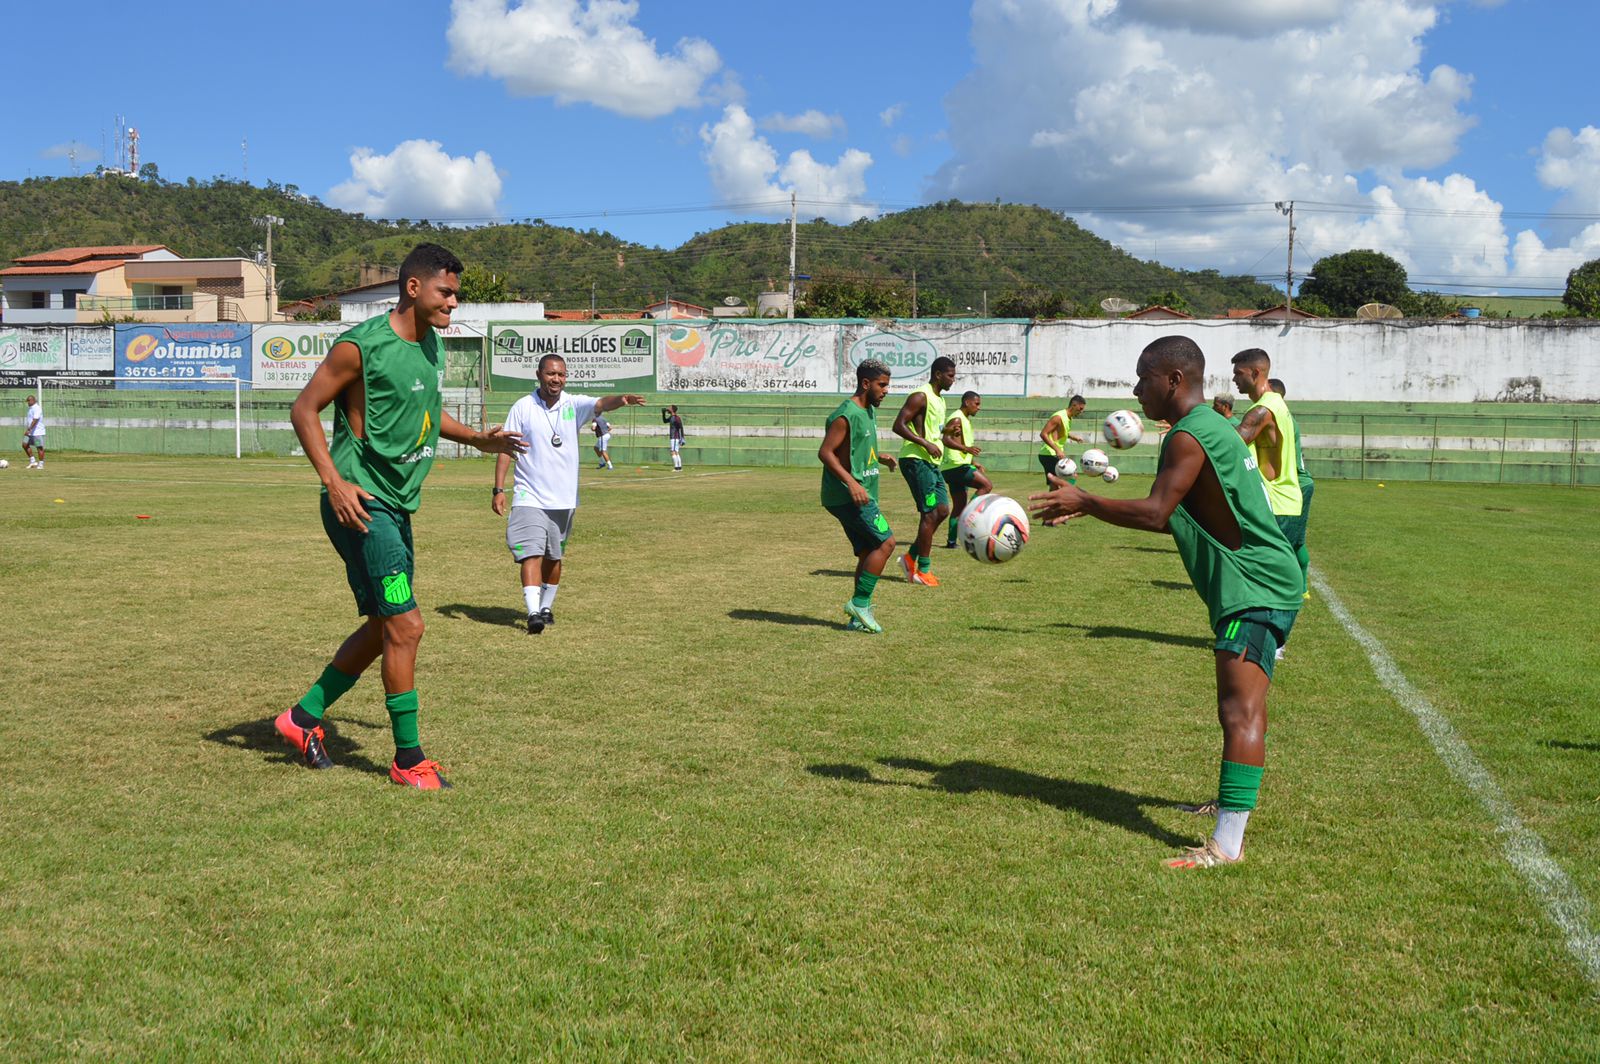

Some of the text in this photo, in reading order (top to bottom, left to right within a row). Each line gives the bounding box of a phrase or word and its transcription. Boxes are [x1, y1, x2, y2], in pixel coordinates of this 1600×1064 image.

[20, 342, 48, 353] HARAS
[528, 334, 616, 353] UNAÍ LEILÕES
[624, 337, 649, 350] UL
[710, 328, 818, 369] Pro Life
[501, 355, 522, 363] LEILÃO
[859, 346, 929, 367] Josias
[959, 351, 1007, 366] 9.9844-0674
[261, 361, 307, 369] MATERIAIS
[264, 371, 313, 381] (38) 3677-28
[669, 378, 817, 389] (38) 3676-1366 3677-4464
